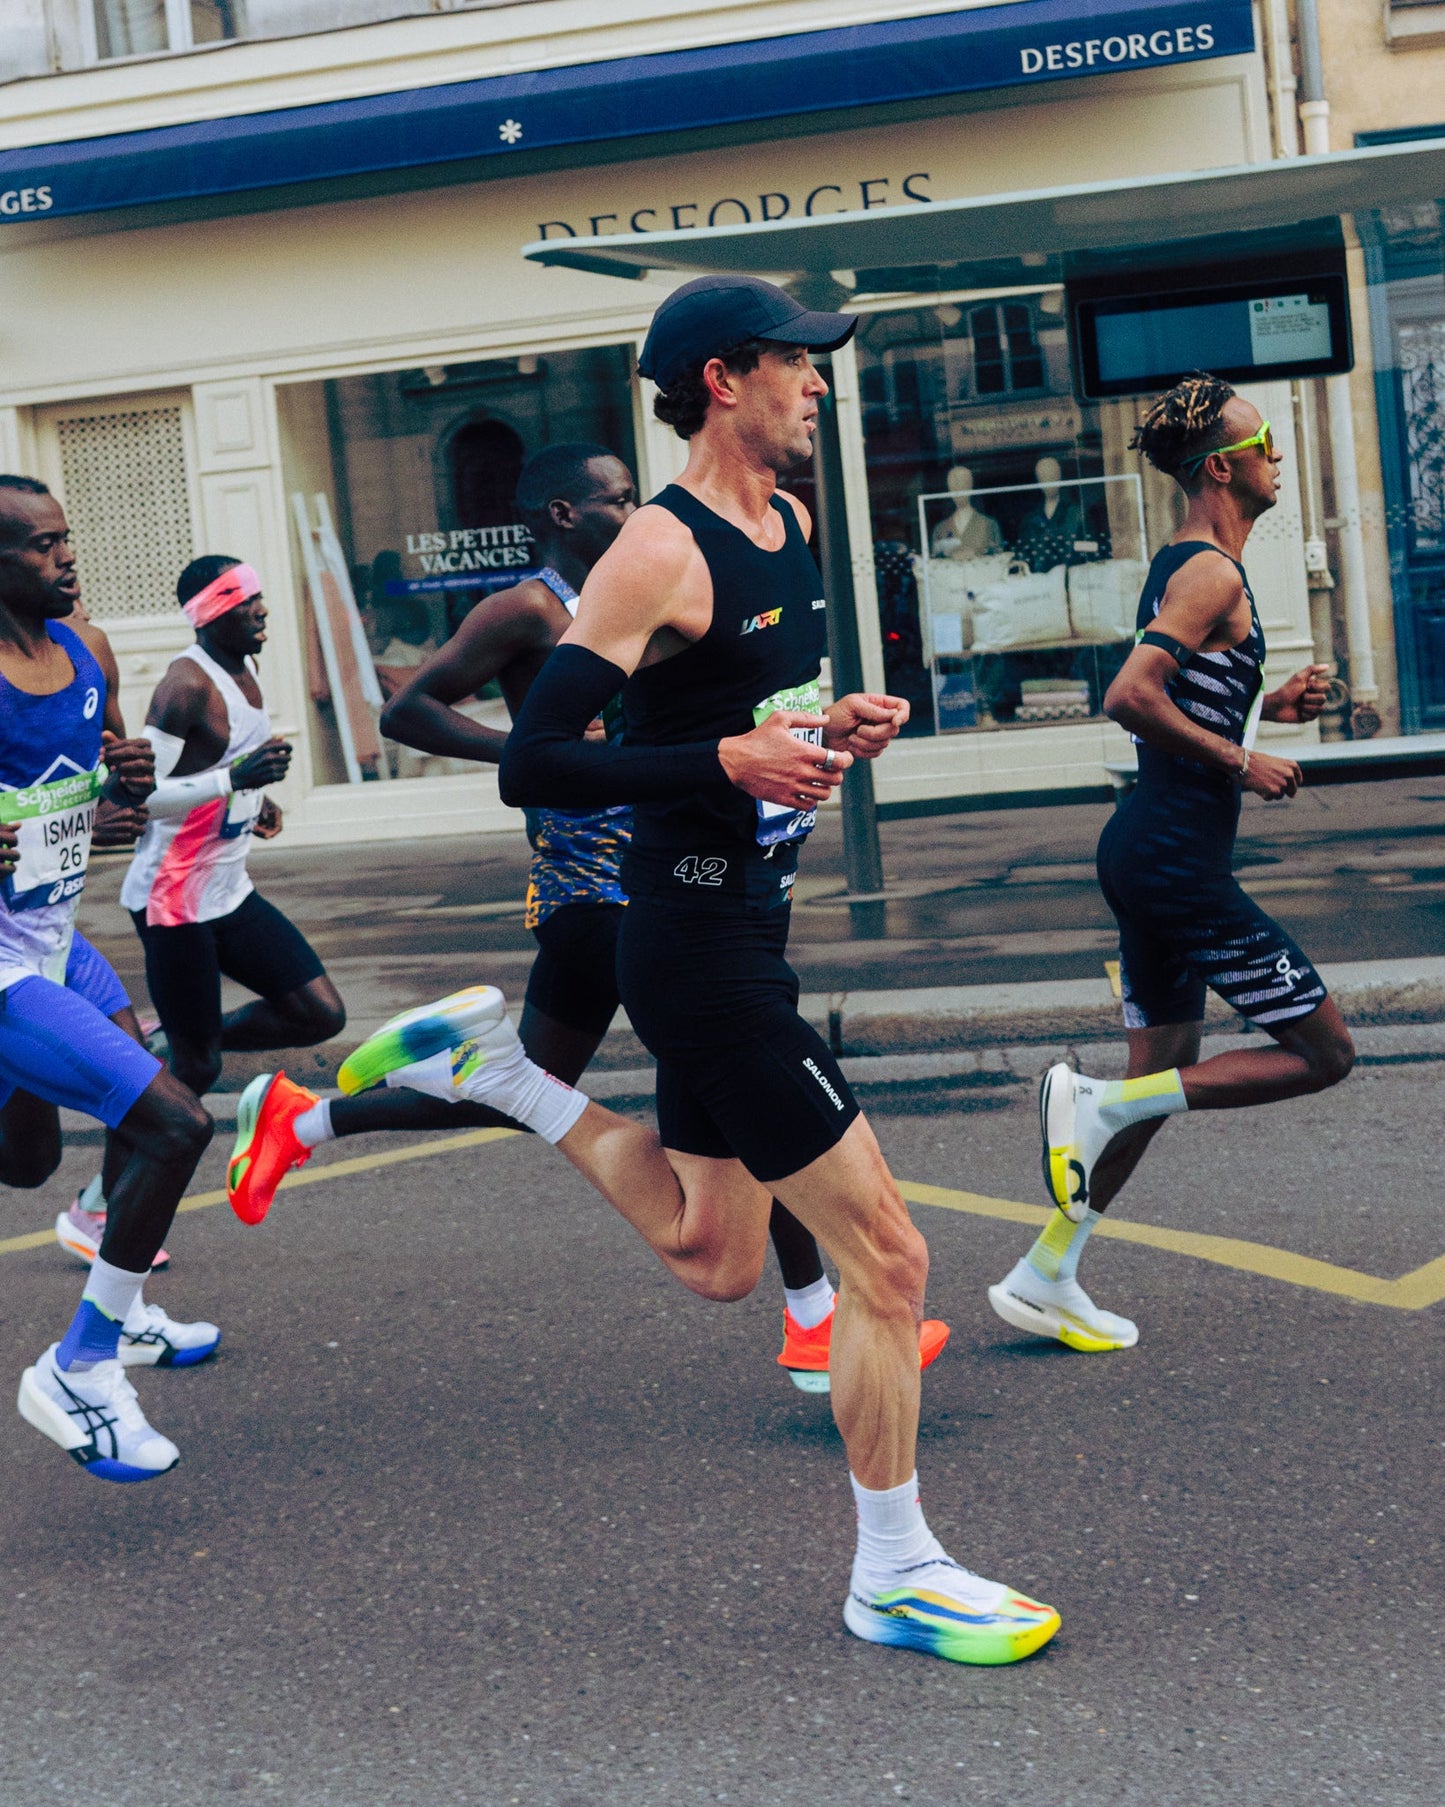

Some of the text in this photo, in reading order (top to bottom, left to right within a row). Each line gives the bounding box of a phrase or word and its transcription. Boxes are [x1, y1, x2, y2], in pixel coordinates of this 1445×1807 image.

[1020, 24, 1215, 74] DESFORGES
[406, 532, 447, 555] LES
[419, 546, 531, 574] VACANCES
[16, 777, 92, 814] Schneider
[59, 843, 82, 872] 26
[673, 855, 728, 886] 42
[802, 1056, 845, 1112] SALOMON
